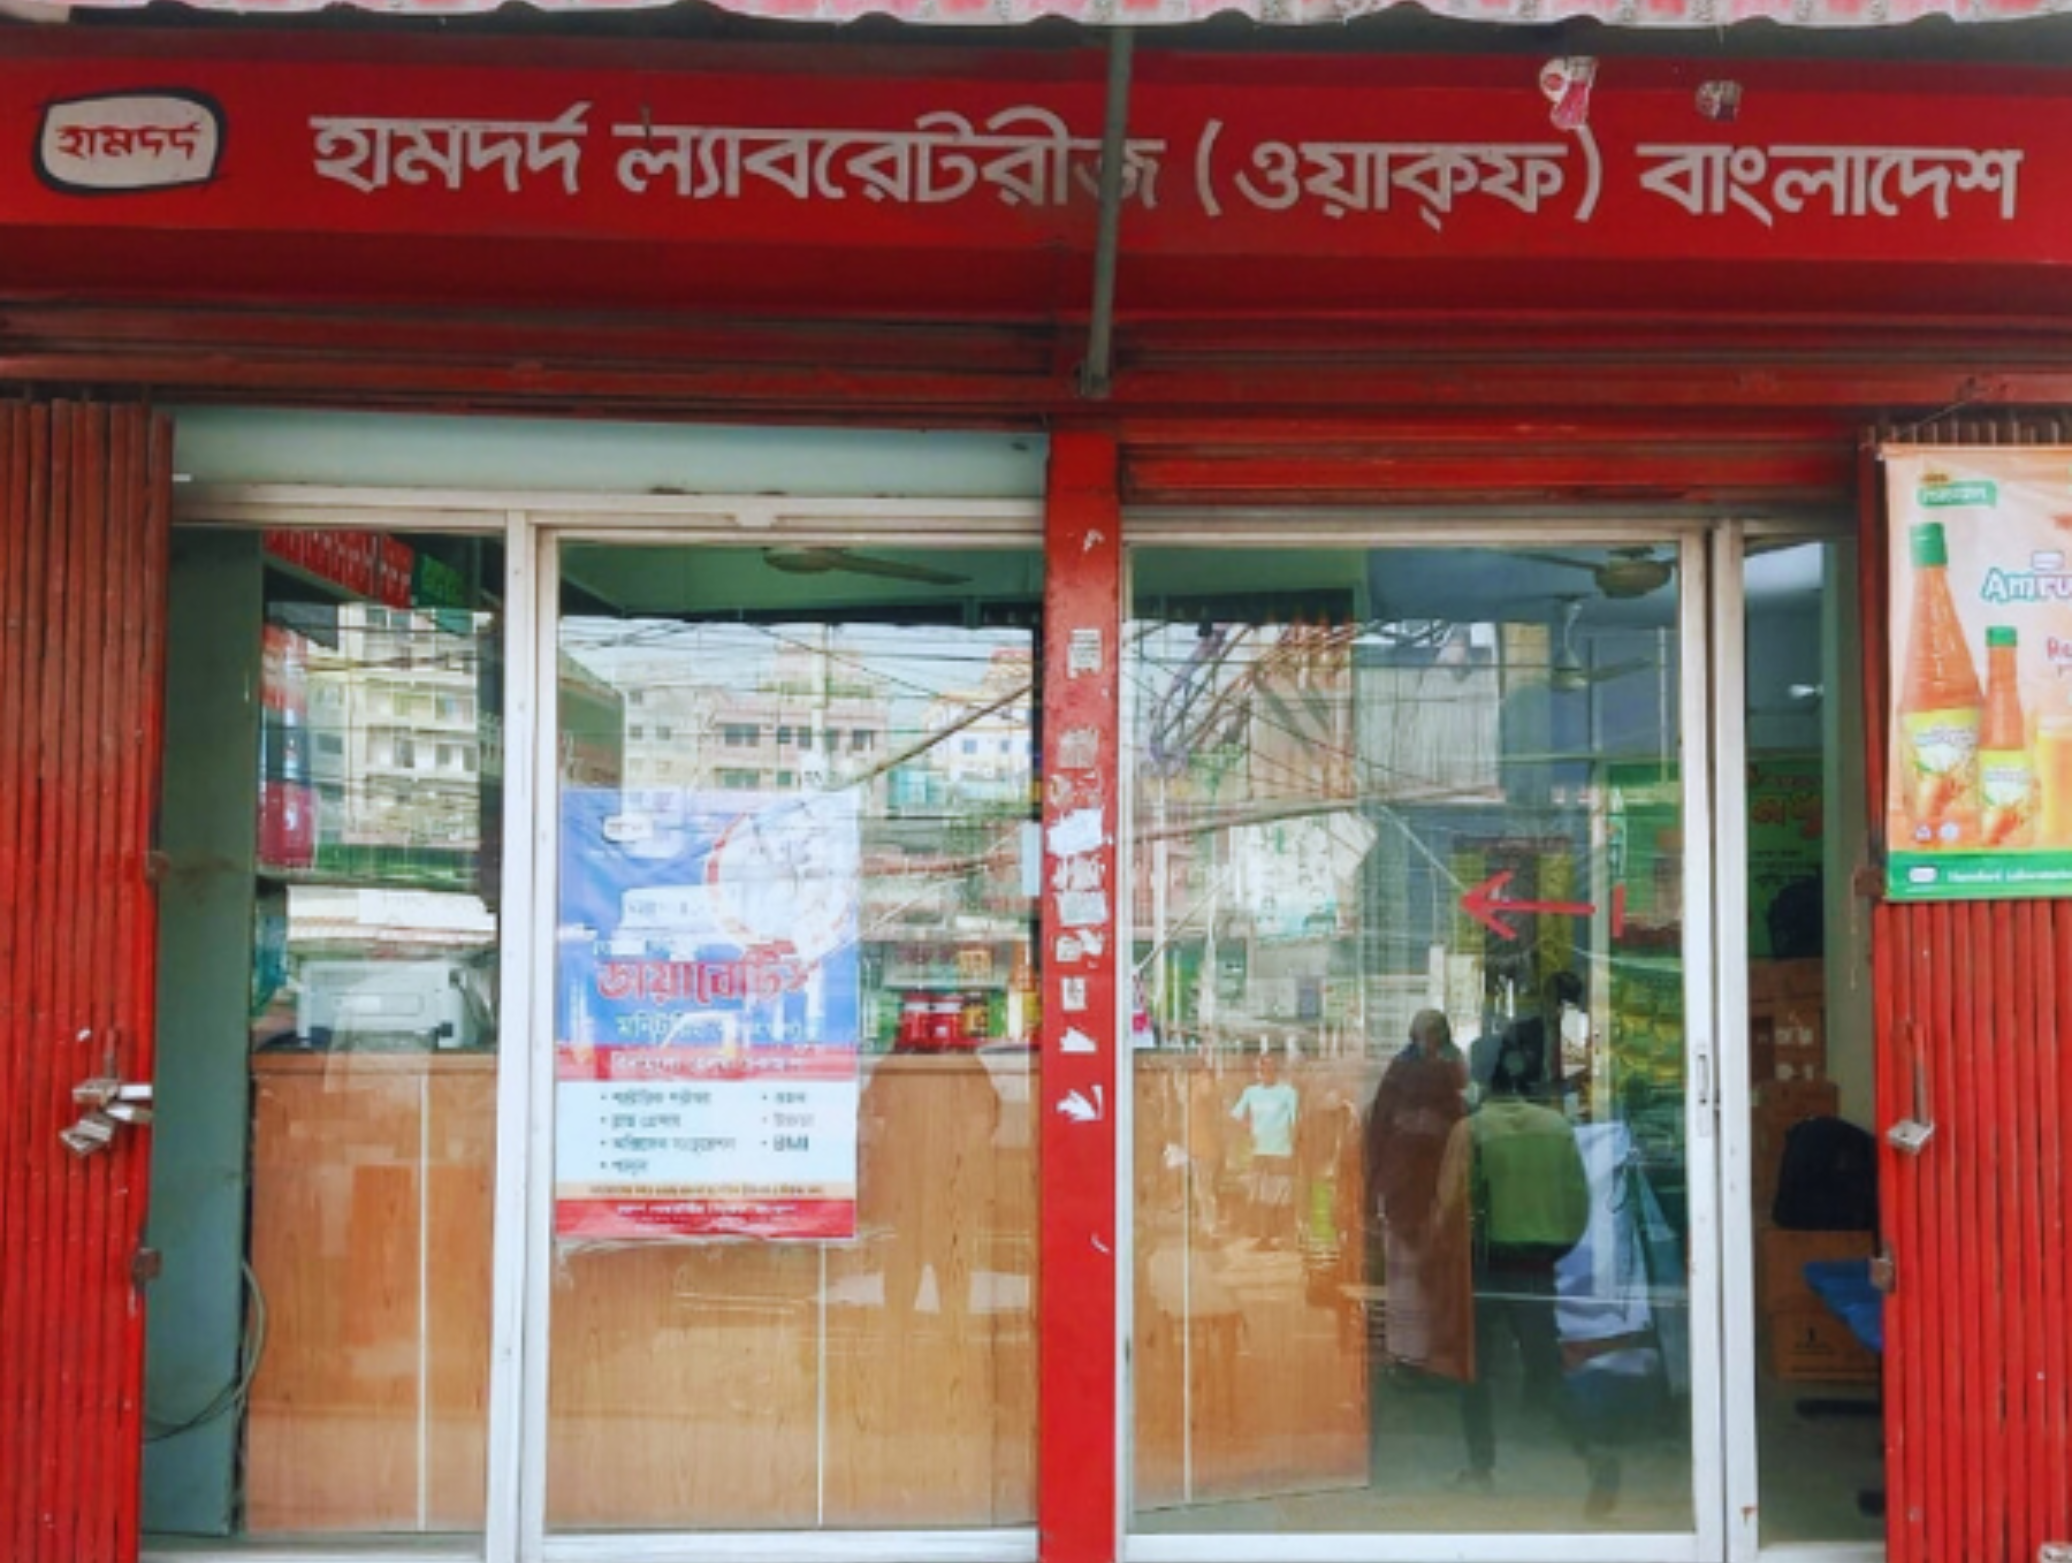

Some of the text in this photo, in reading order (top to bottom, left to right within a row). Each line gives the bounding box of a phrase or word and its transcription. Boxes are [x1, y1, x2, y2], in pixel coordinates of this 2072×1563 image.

[56, 121, 201, 160] হামদর্দ
[309, 101, 592, 194] হামদর্দ
[1635, 144, 2023, 227] বাংলাদেশ
